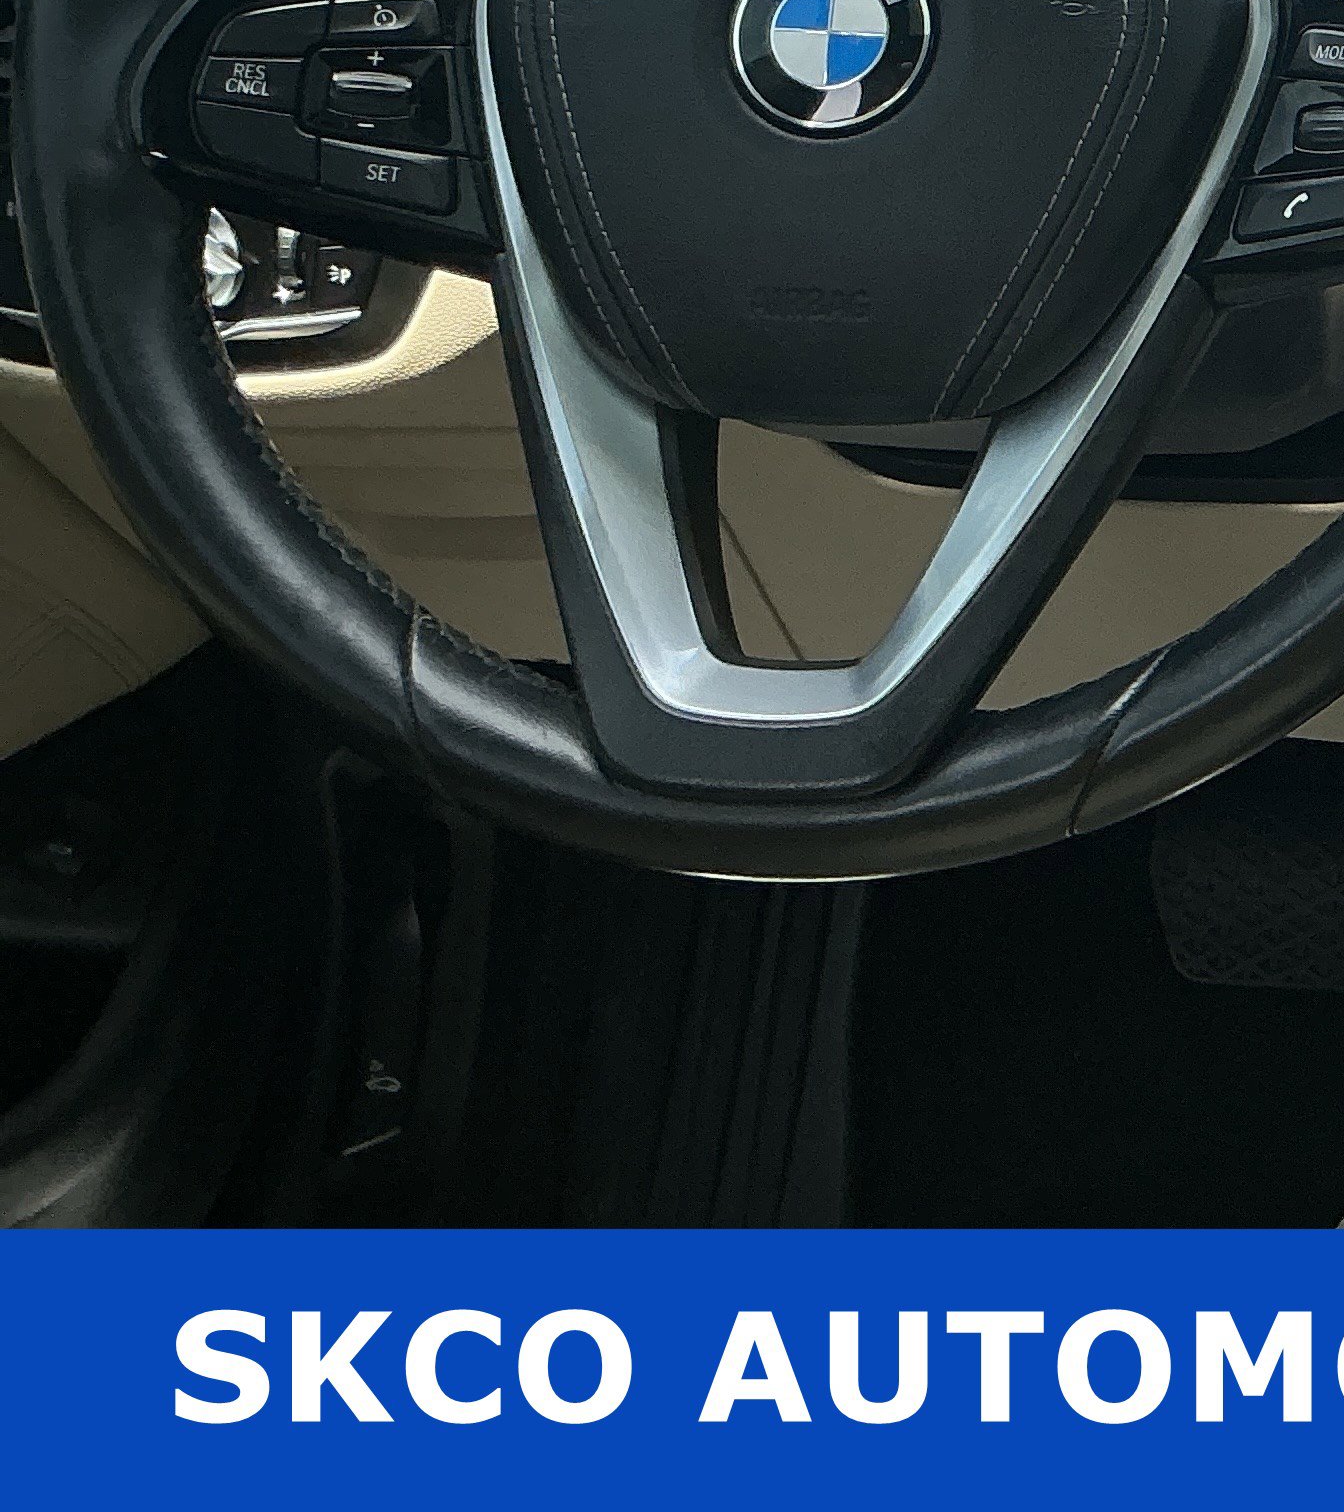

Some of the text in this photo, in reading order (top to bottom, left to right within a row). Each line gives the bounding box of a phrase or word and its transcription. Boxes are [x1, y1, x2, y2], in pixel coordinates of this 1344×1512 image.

[233, 62, 267, 80] RES
[225, 78, 270, 97] CNCL
[365, 163, 401, 184] SET
